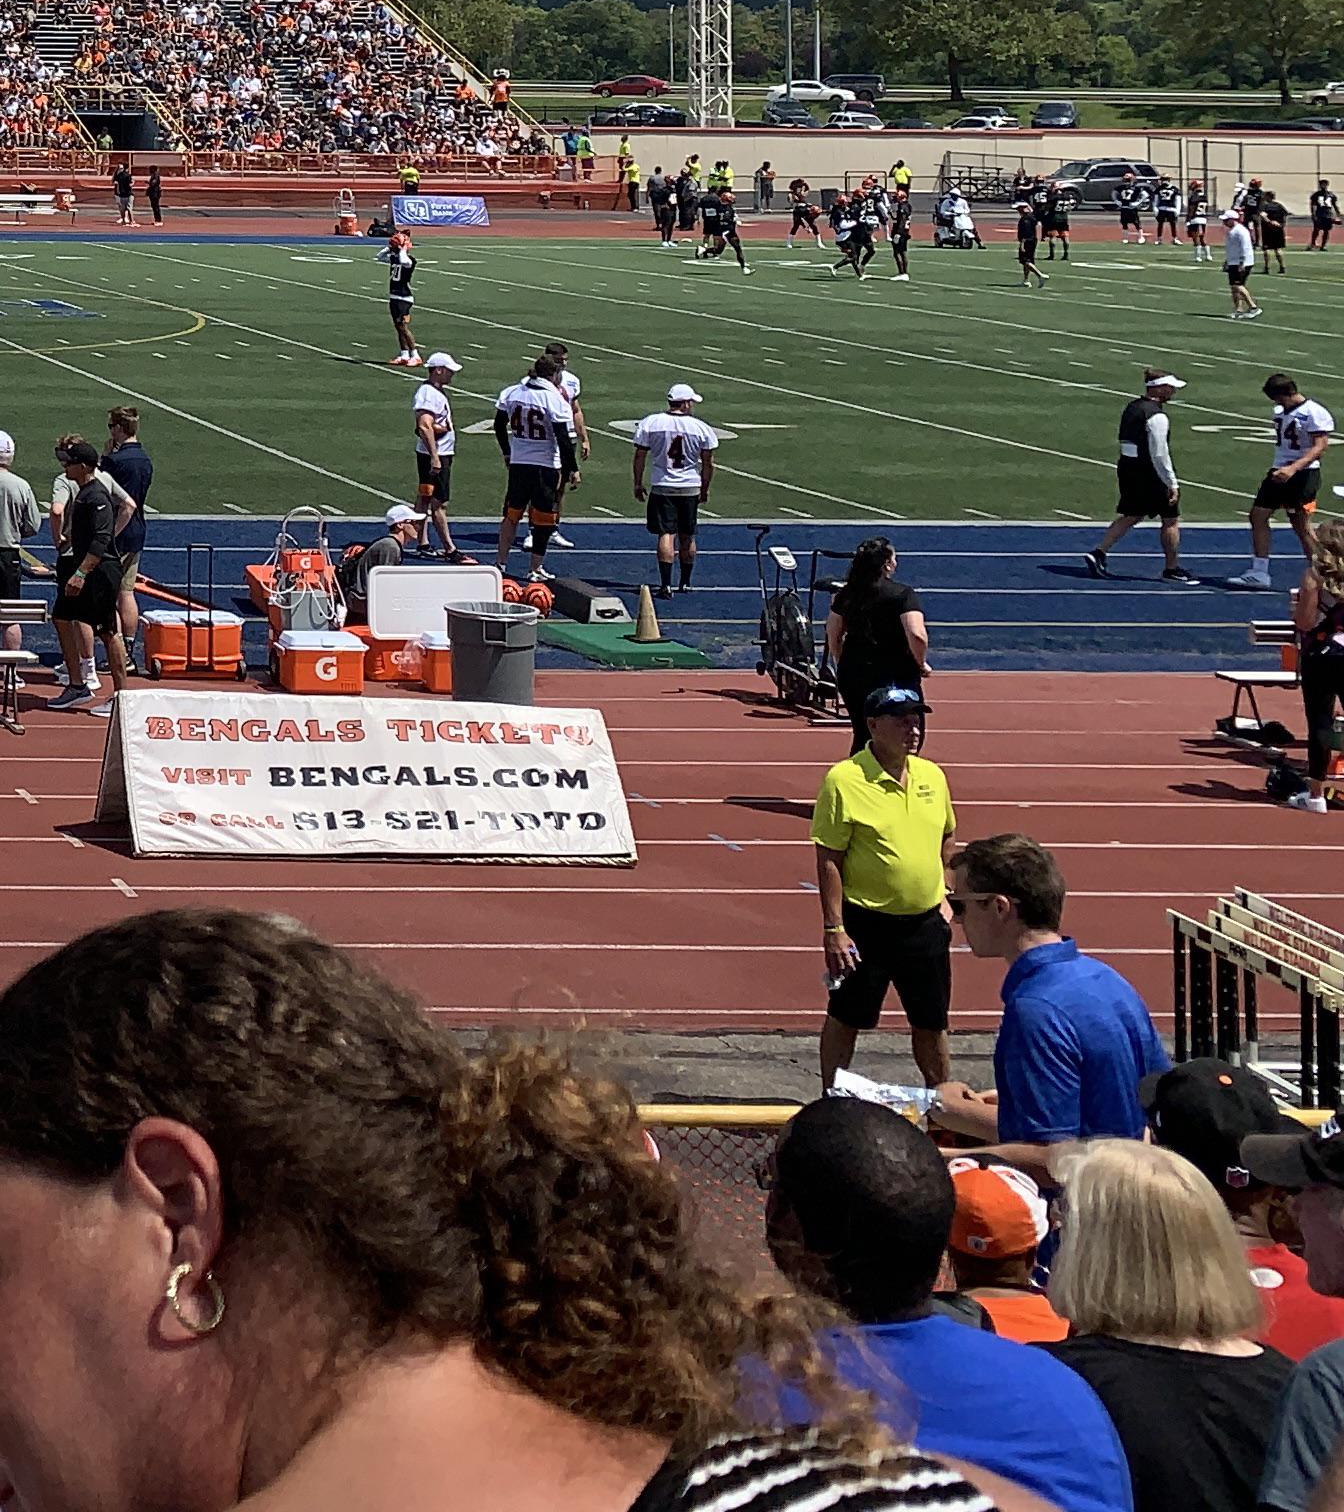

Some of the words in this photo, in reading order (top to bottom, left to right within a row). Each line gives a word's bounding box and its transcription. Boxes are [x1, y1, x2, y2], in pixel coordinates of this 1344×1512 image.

[511, 402, 547, 440] 46
[667, 435, 686, 469] 4
[299, 556, 311, 569] G
[315, 656, 338, 681] G
[144, 715, 366, 743] BENGALS
[386, 718, 594, 747] TICKETS
[160, 766, 252, 786] VISIT
[268, 764, 590, 790] BENGALS.COM
